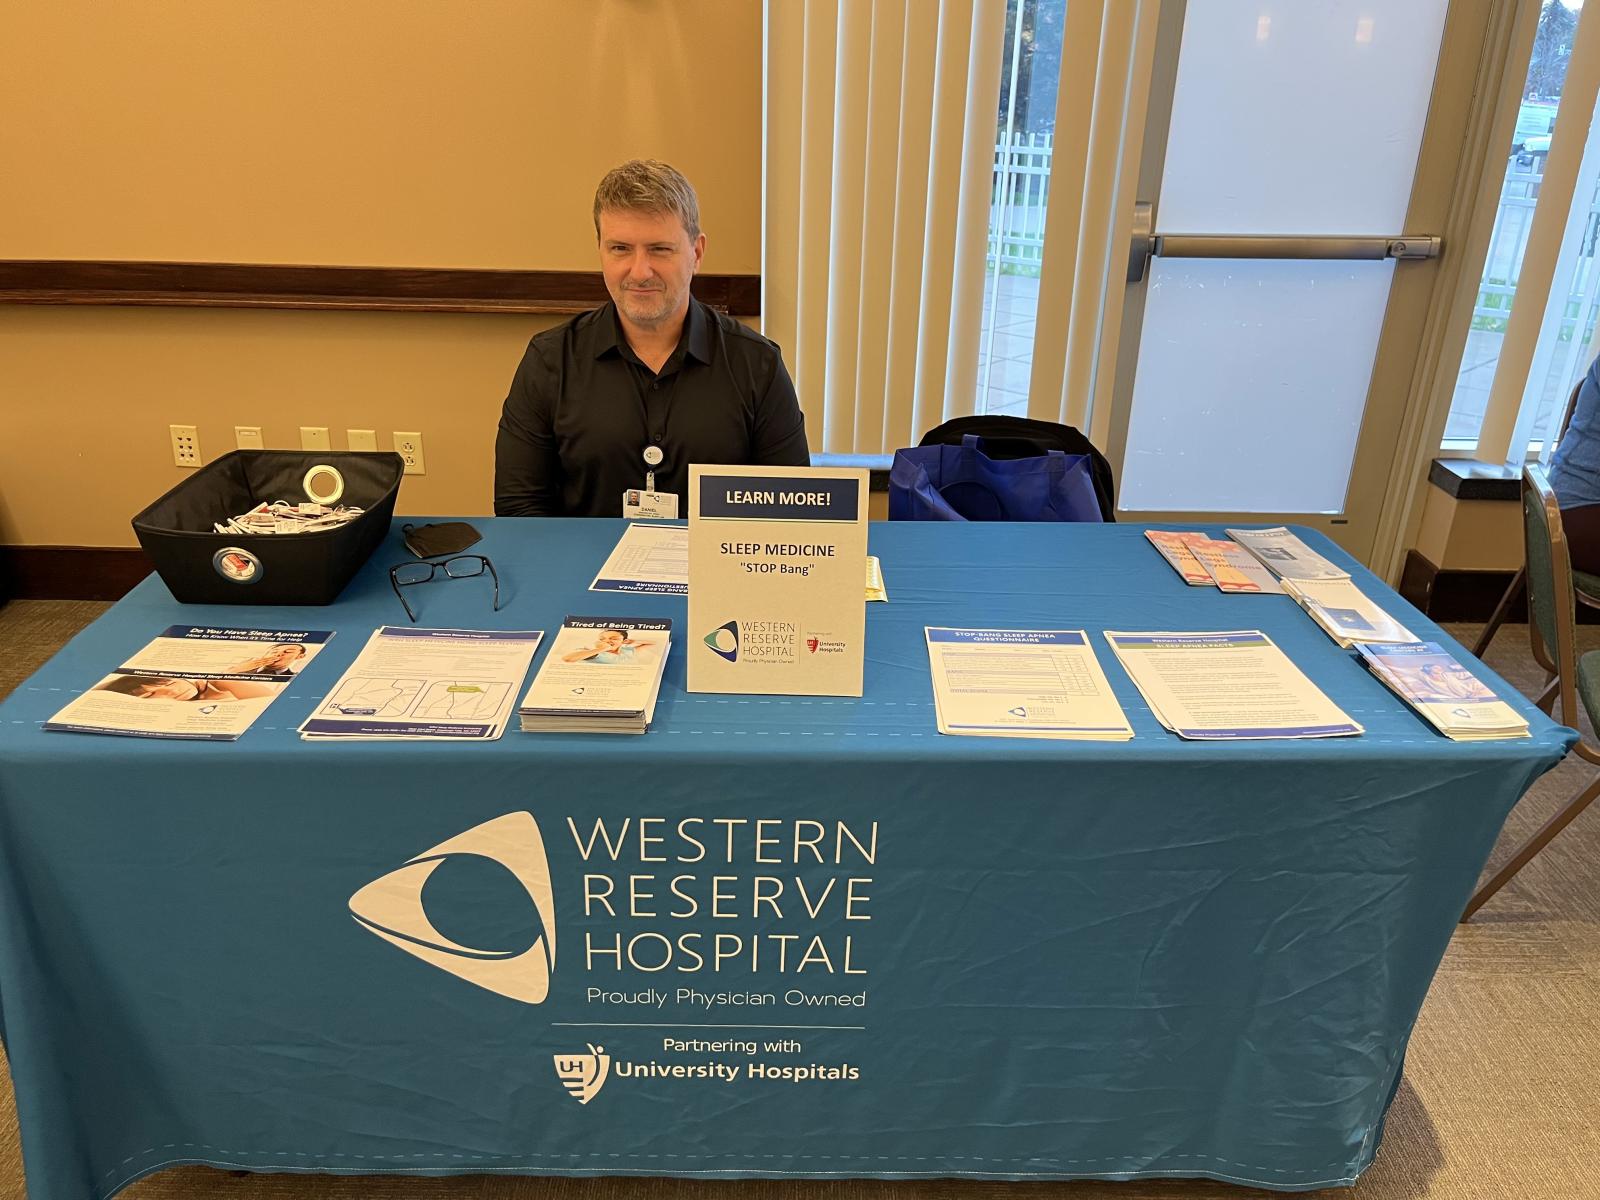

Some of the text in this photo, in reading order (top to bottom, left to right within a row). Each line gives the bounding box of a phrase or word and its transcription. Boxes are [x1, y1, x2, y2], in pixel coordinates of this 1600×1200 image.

[726, 490, 831, 506] LEARN MORE!
[720, 542, 835, 557] SLEEP MEDICINE
[740, 562, 815, 577] "STOP Bang"
[608, 622, 635, 630] Being
[741, 621, 795, 632] WESTERN
[743, 634, 795, 644] RESERVE
[743, 646, 794, 656] HOSPITAL
[566, 816, 878, 864] WESTERN
[583, 874, 873, 920] RESERVE
[585, 932, 867, 974] HOSPITAL
[587, 987, 866, 1010] Proudly Physician Owned
[663, 1038, 801, 1055] Partnering with
[615, 1061, 860, 1083] University Hospitals
